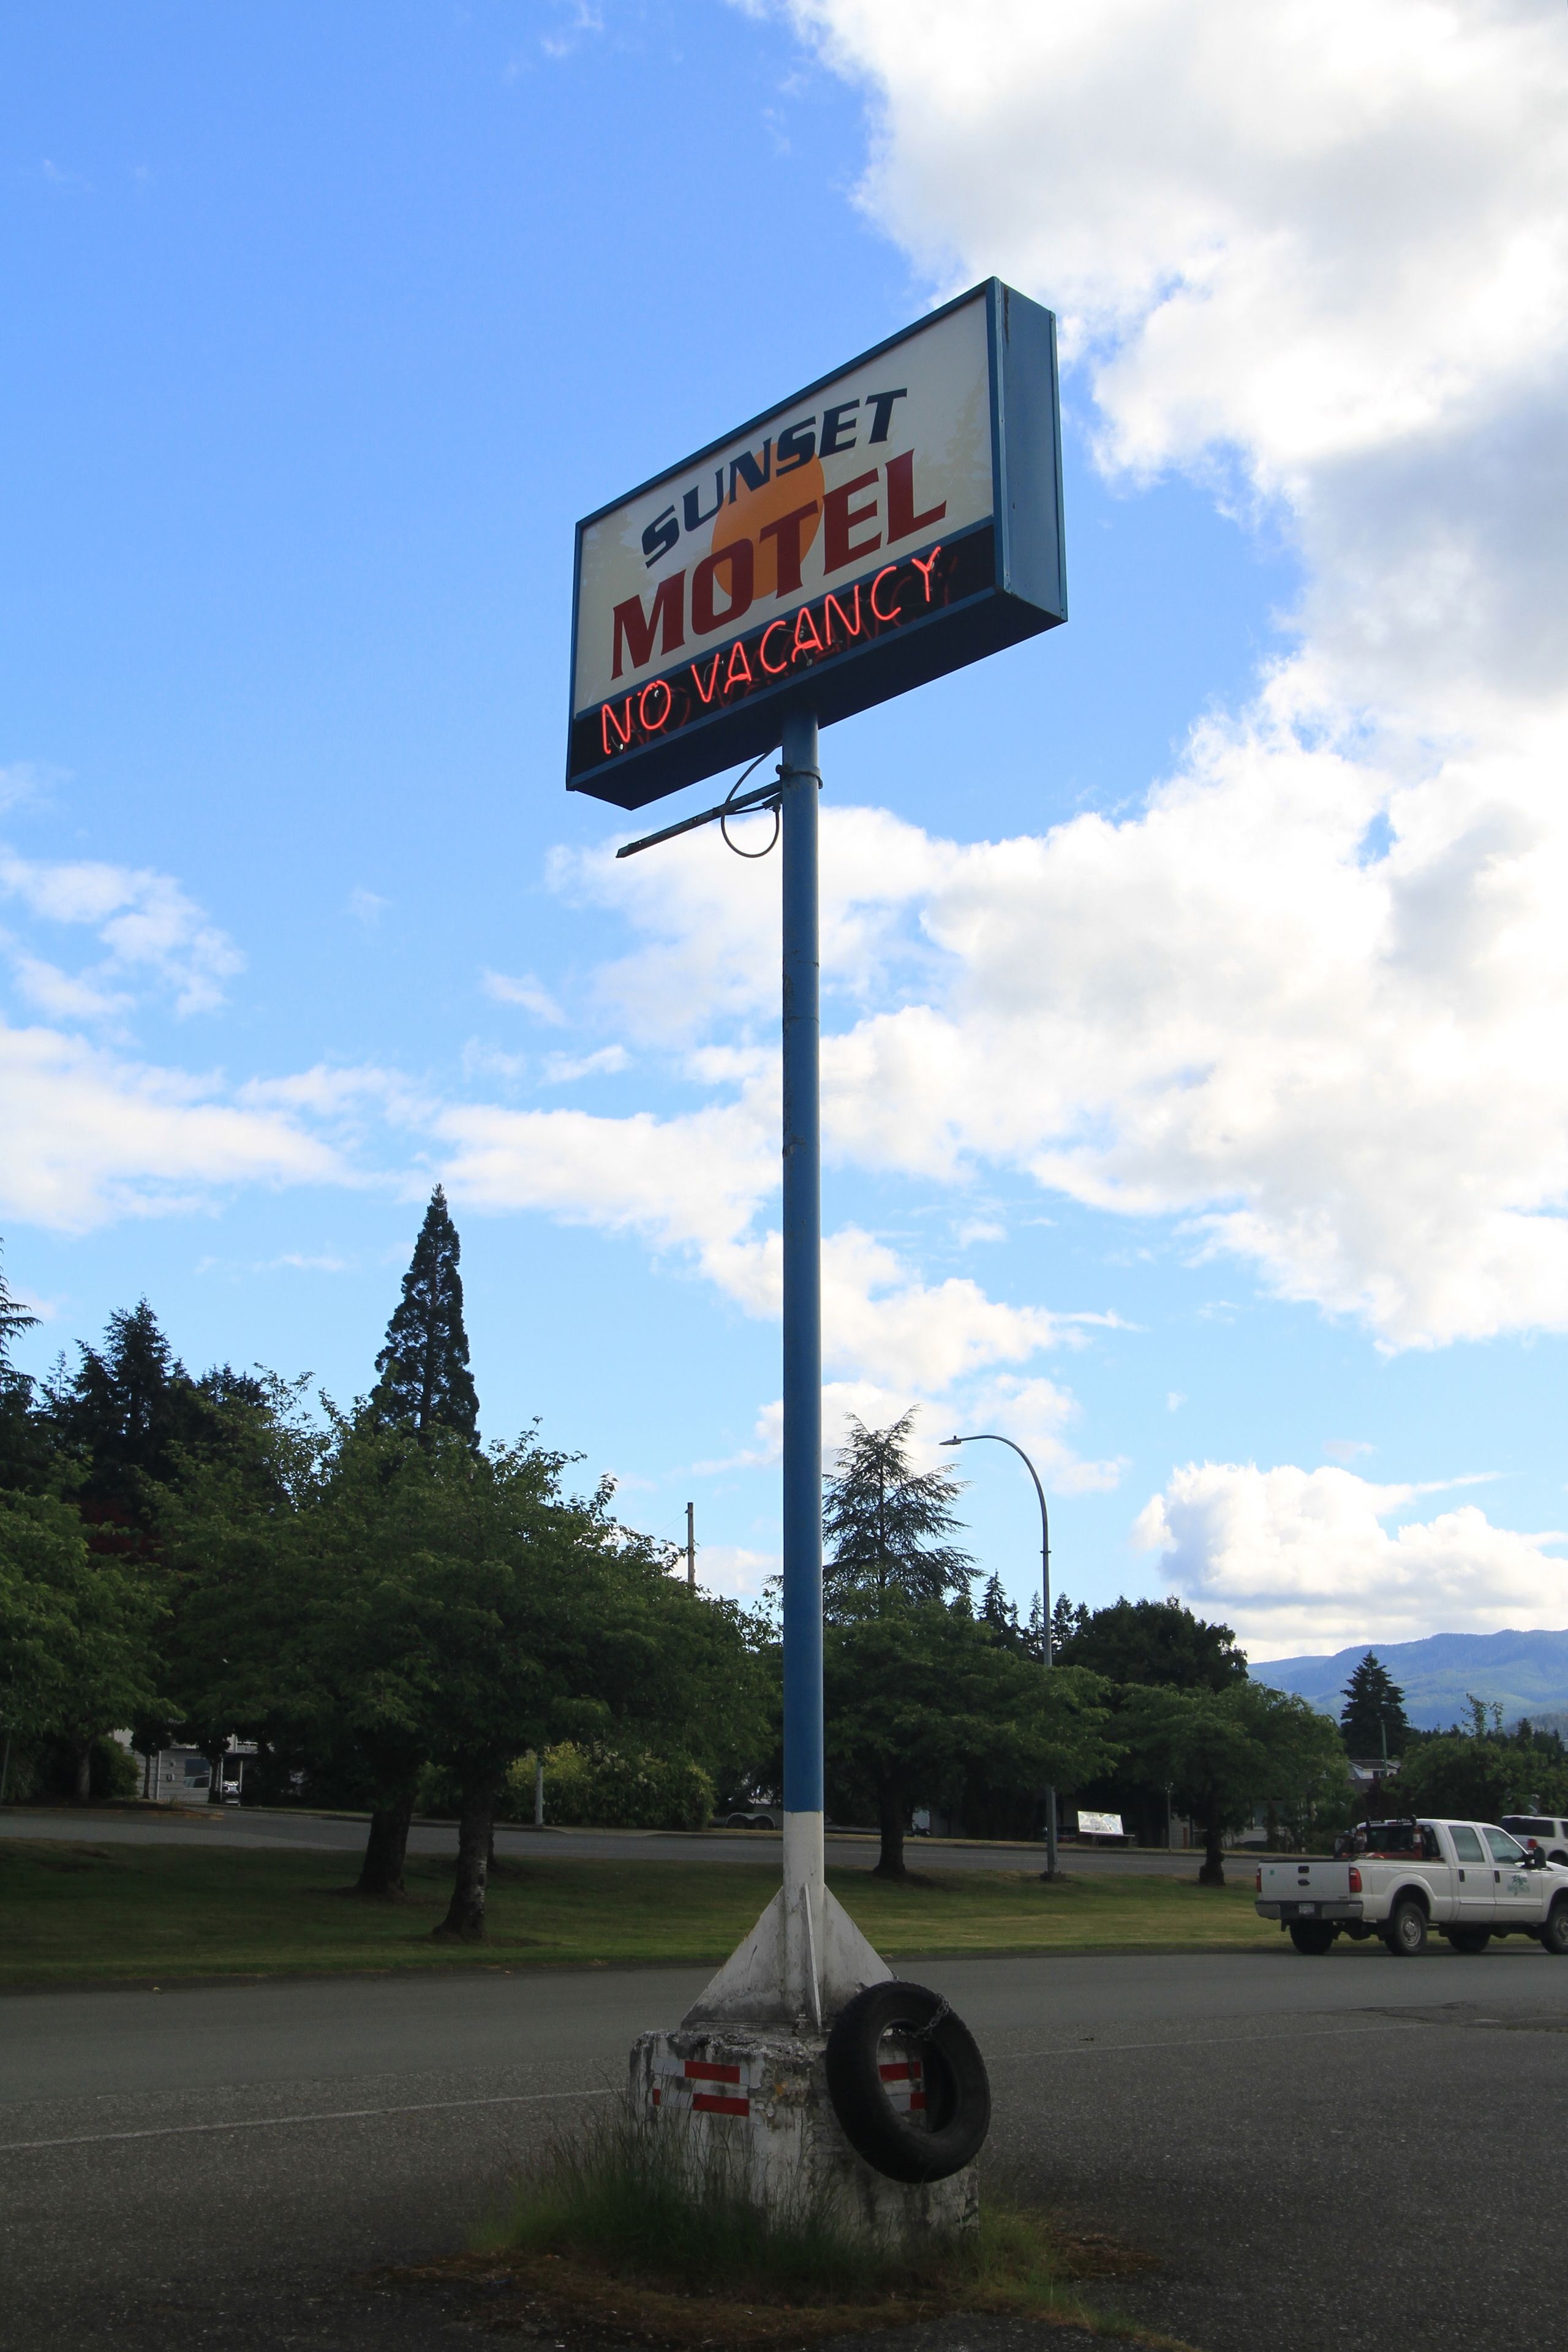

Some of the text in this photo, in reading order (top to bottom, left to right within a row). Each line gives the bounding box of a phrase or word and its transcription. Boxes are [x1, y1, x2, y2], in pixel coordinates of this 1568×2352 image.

[611, 449, 946, 680] MOTEL
[641, 389, 907, 568] SUNSET
[601, 546, 941, 754] NO VACANCY
